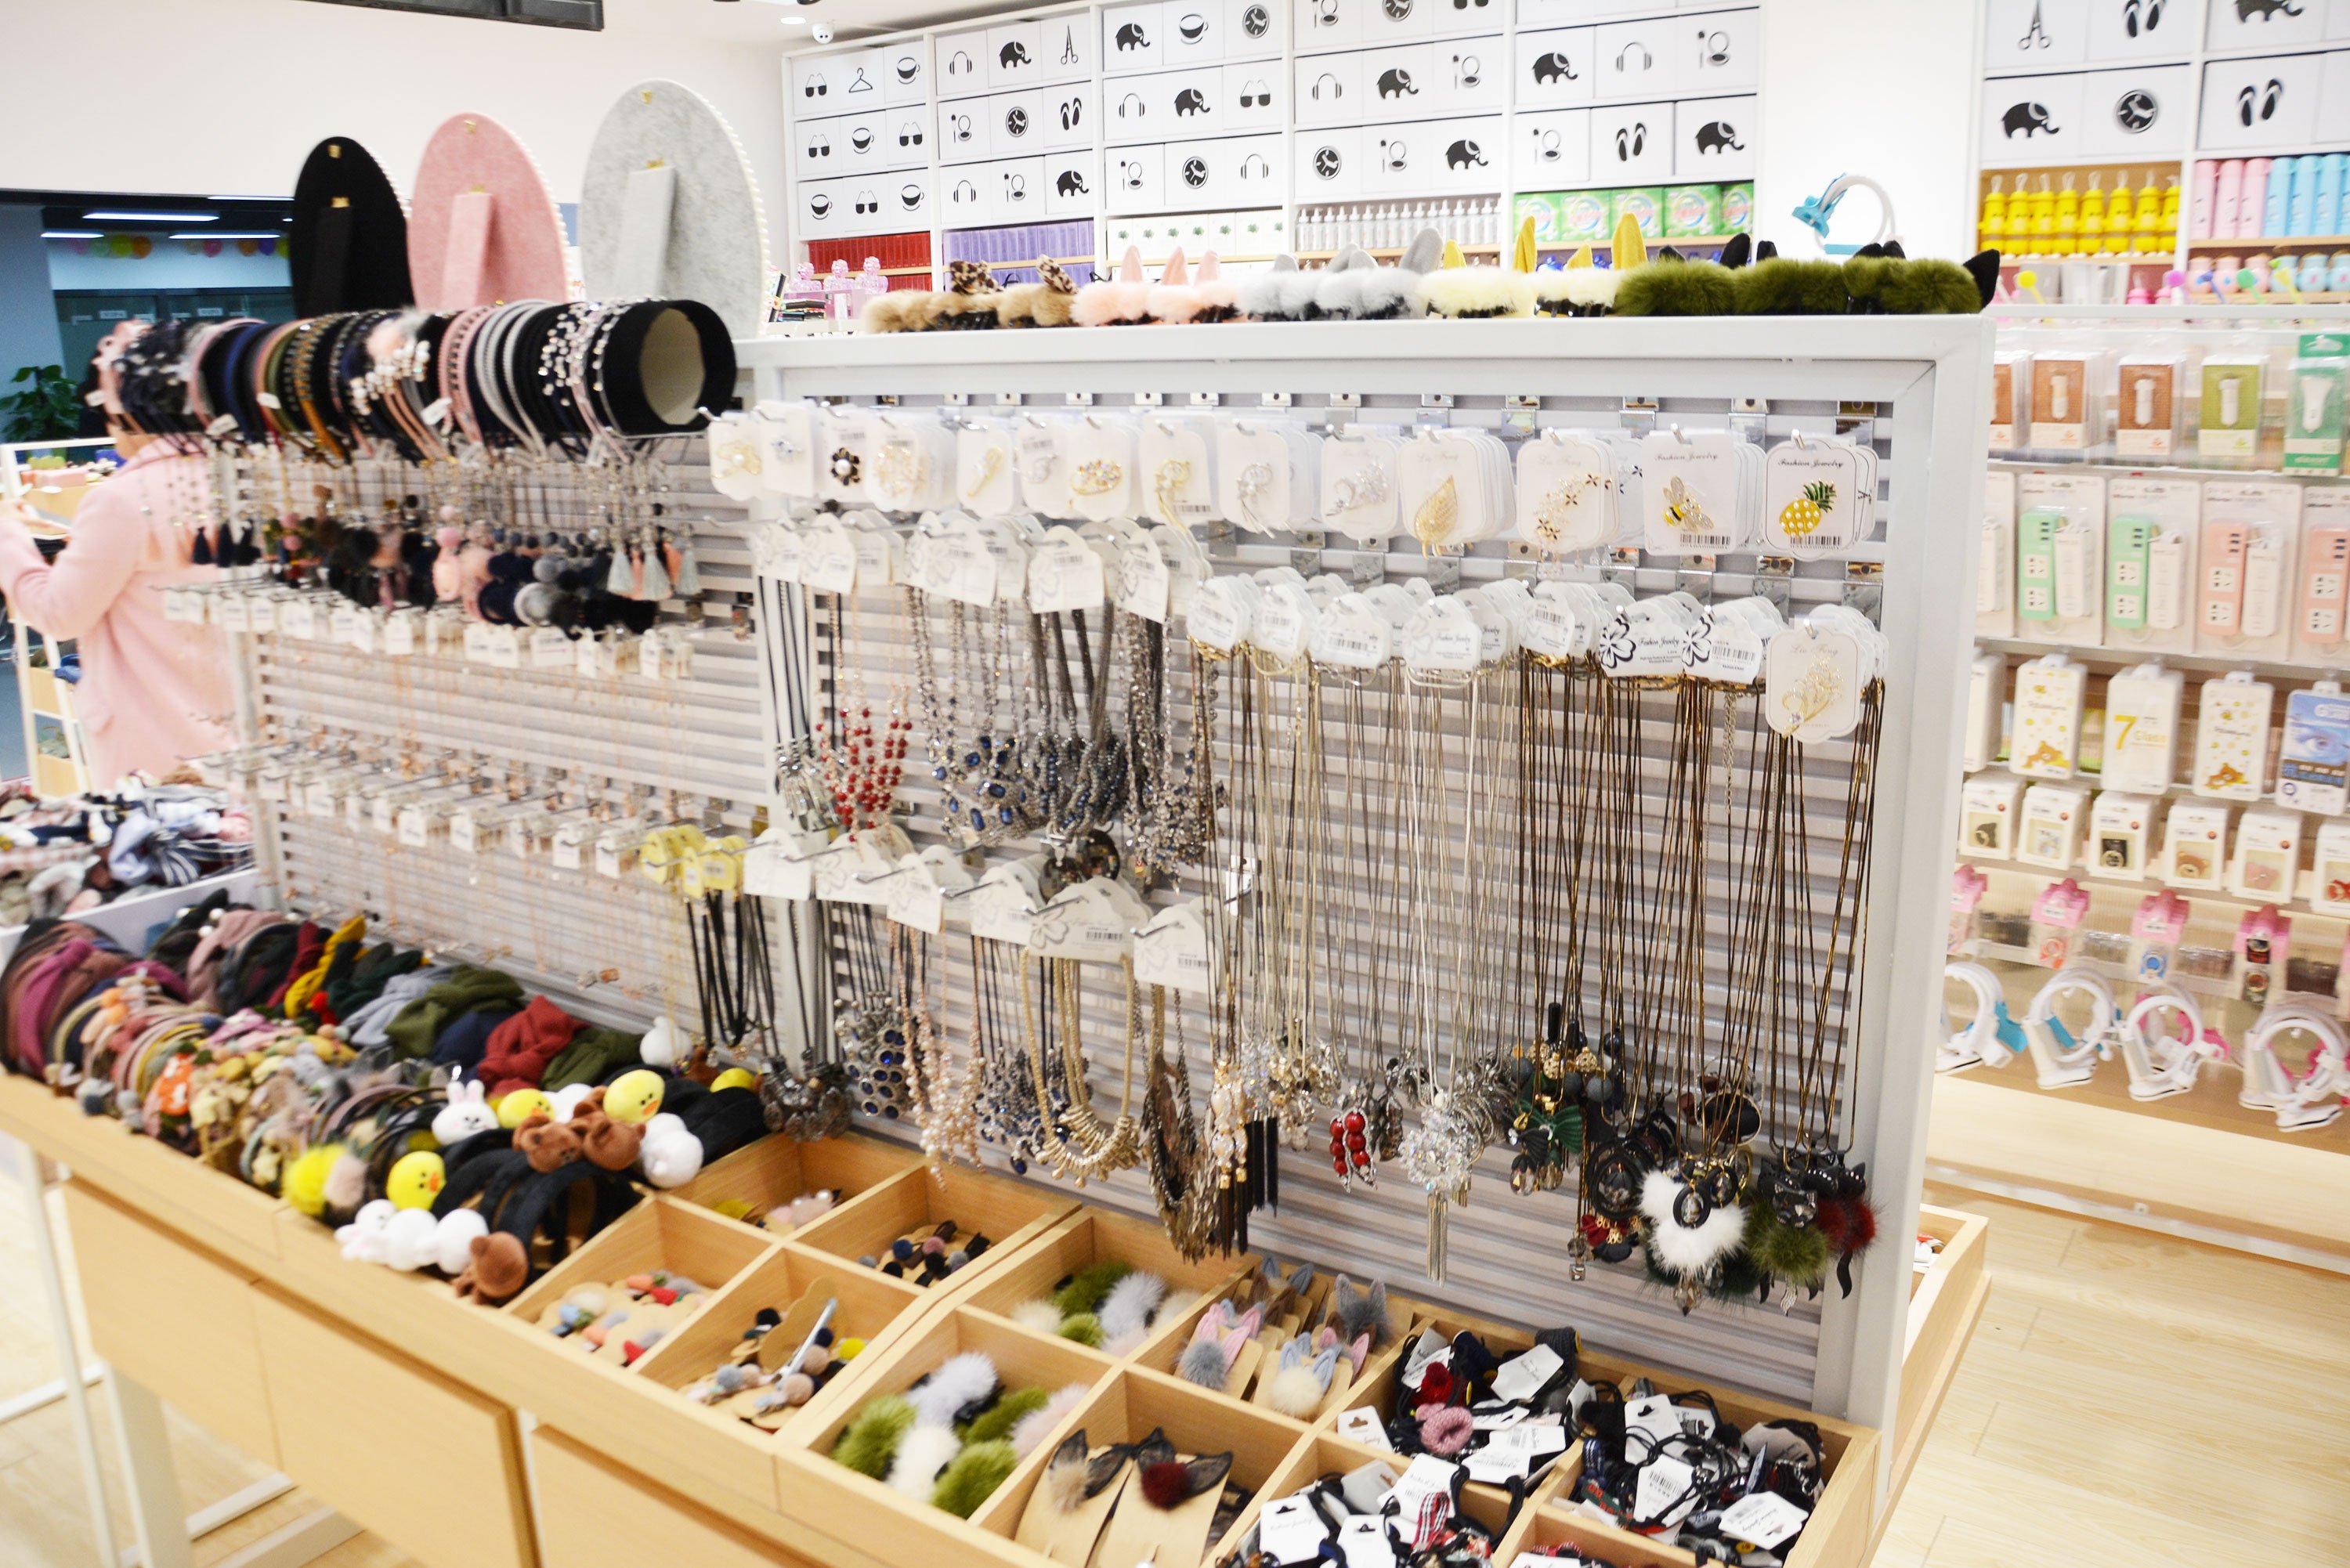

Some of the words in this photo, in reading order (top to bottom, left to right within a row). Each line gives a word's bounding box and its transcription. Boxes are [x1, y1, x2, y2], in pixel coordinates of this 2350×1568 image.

[1777, 458, 1810, 467] Fashion
[1810, 459, 1844, 470] Jewelry
[2113, 714, 2138, 750] 7
